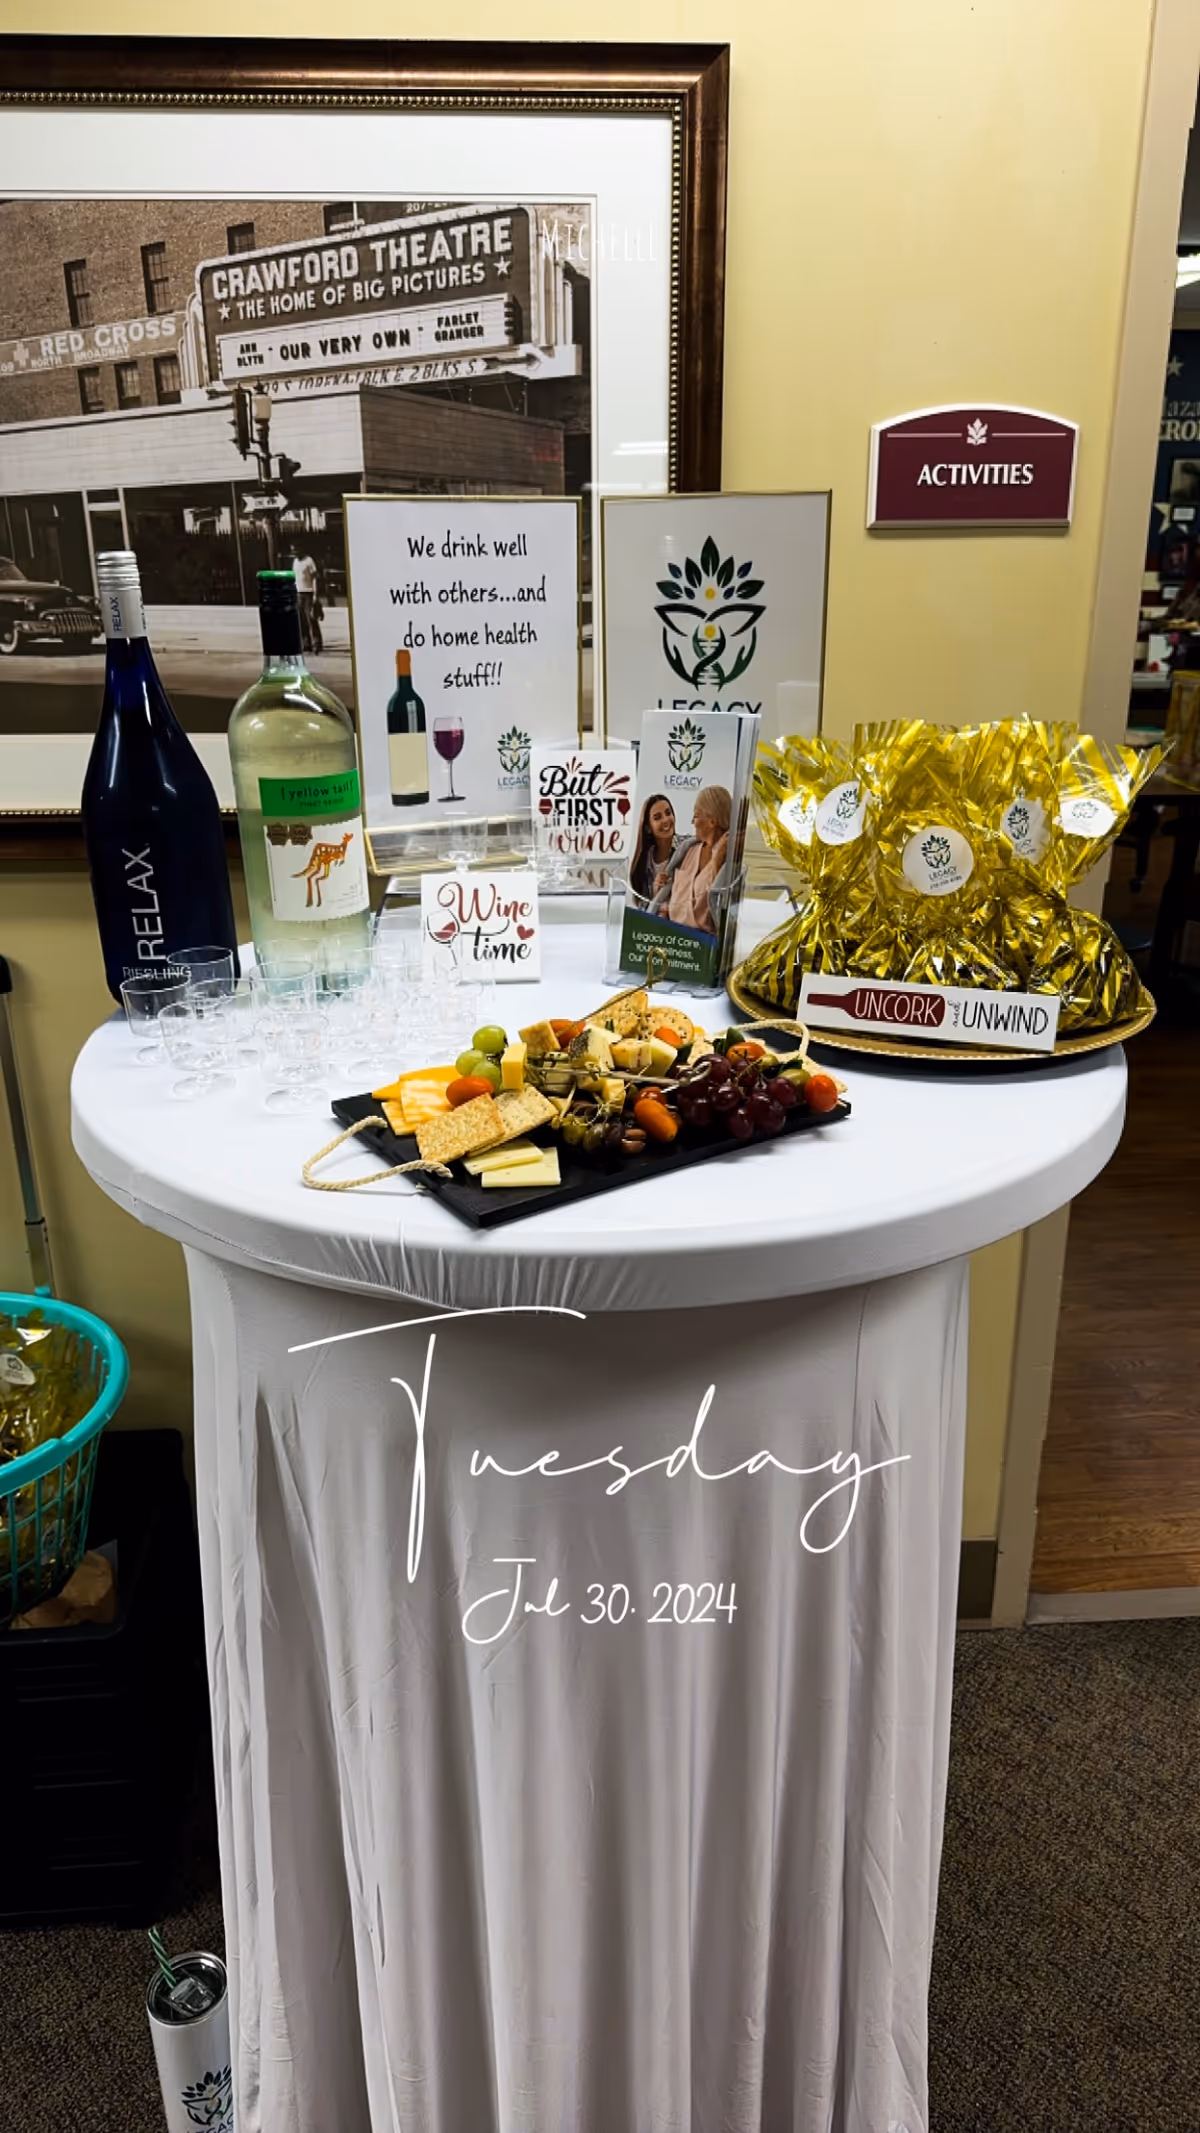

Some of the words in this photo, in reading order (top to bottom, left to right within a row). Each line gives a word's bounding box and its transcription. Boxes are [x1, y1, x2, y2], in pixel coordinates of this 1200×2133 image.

[212, 246, 359, 300] CRAWFORD
[370, 217, 512, 272] THEATRE
[236, 299, 265, 320] THE
[270, 290, 315, 315] HOME
[323, 284, 346, 305] OF
[353, 279, 385, 301] BIG
[392, 262, 485, 296] PICTURES
[434, 325, 484, 343] GRANGER
[437, 312, 479, 328] FARLEY
[41, 333, 84, 356] RED
[94, 318, 176, 348] CROSS
[319, 335, 361, 357] VERY
[31, 355, 62, 369] NORTH
[74, 342, 130, 361] BROADWAY
[917, 463, 1034, 486] ACTIVITIES
[407, 535, 436, 558] We
[441, 529, 488, 558] drink
[493, 533, 527, 558] well
[390, 581, 432, 605] with
[109, 597, 122, 631] RELAX
[403, 620, 425, 648] do
[431, 624, 480, 647] home
[485, 621, 538, 645] health
[443, 661, 502, 689] stuff!!
[497, 775, 530, 786] LEGAC
[539, 764, 607, 797] But
[664, 775, 703, 787] LEGACY
[554, 798, 616, 826] FIRST
[549, 827, 624, 854] wine
[122, 847, 166, 960] RELAX
[438, 882, 533, 923] Wine
[468, 924, 532, 964] time
[632, 931, 664, 944] Legacy
[665, 936, 676, 945] Of
[628, 953, 644, 962] Our
[122, 966, 192, 980] RIESLING
[854, 990, 942, 1026] UNCORK
[962, 1000, 1049, 1035] UNWIND
